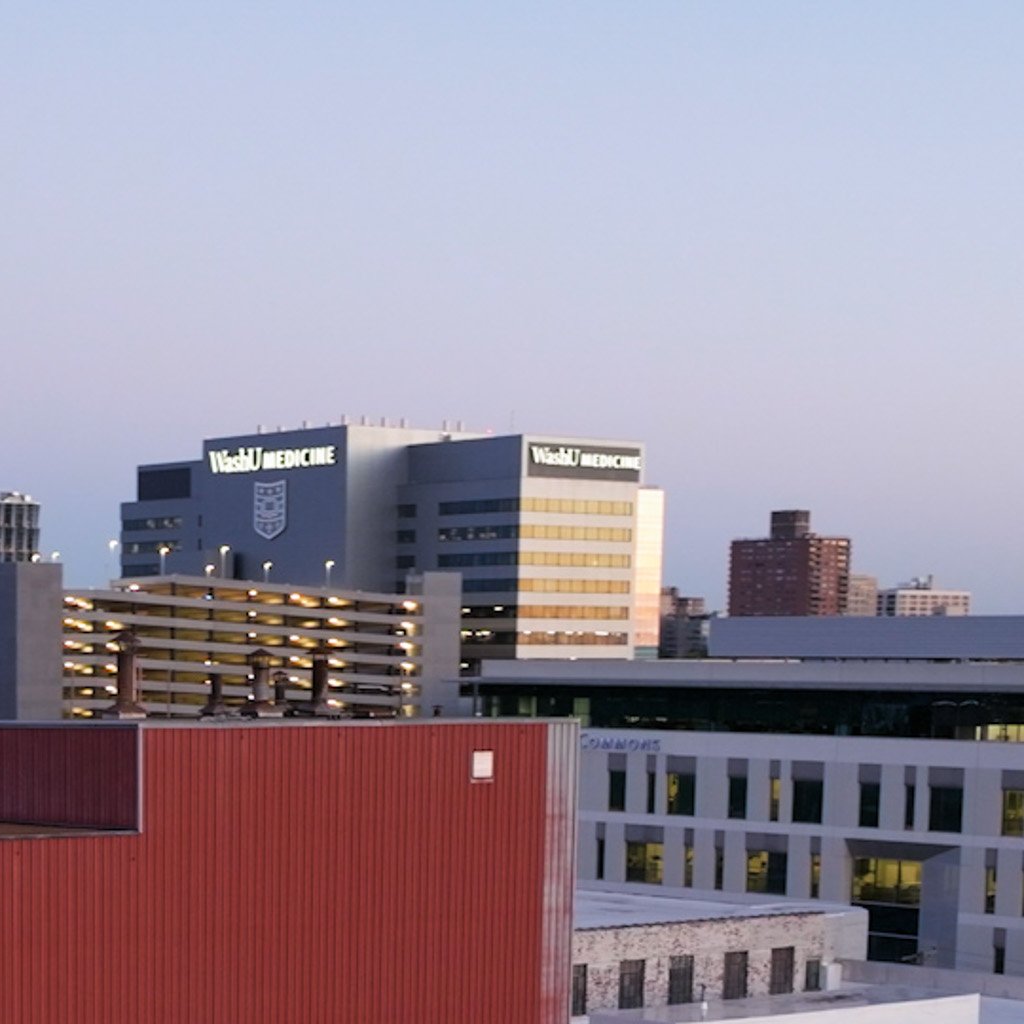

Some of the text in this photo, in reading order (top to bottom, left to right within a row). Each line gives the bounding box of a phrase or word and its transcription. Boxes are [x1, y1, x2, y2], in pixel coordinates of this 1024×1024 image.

[208, 445, 336, 474] WashU MEDICINE
[530, 446, 642, 470] WashU MEDICINE
